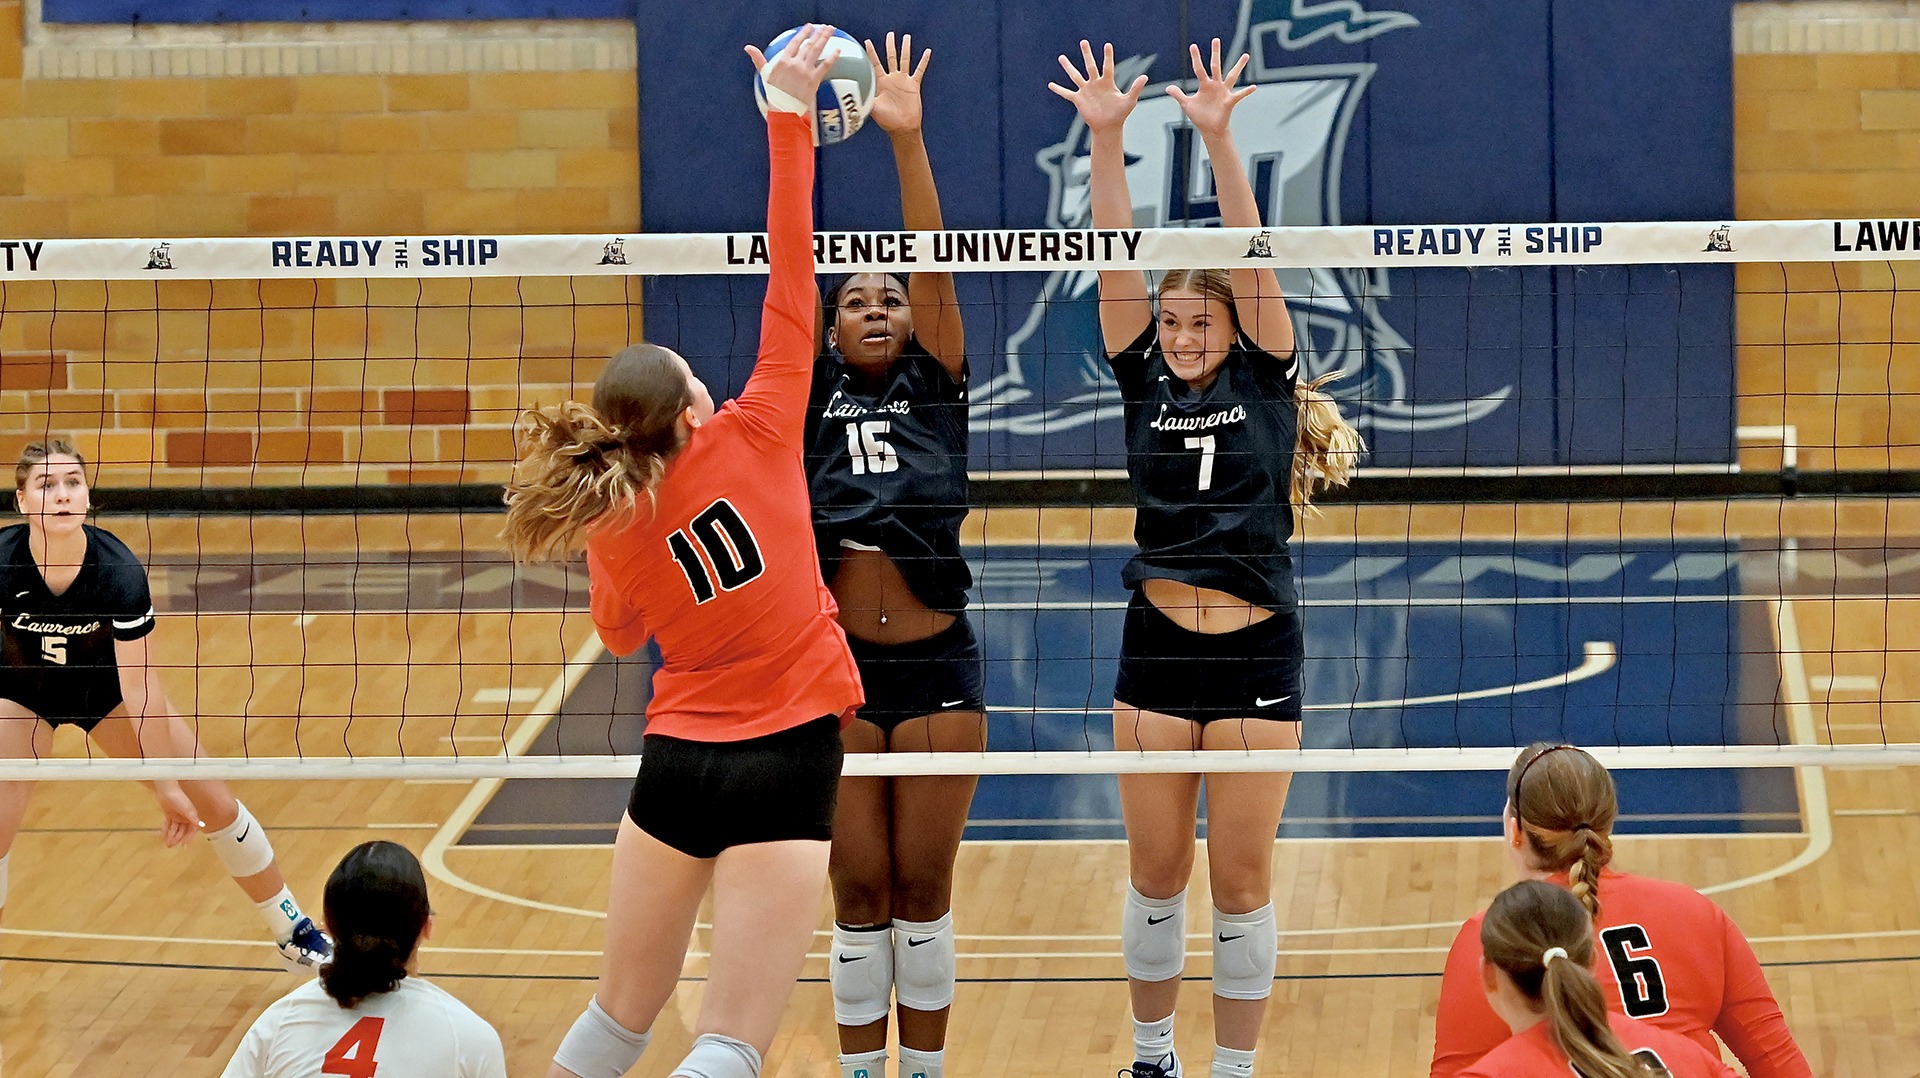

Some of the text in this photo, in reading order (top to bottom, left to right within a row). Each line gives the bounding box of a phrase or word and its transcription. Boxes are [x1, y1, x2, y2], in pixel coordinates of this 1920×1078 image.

[272, 239, 498, 269] READY THE SHIP
[727, 231, 1143, 265] LARENCE UNIVERSITY
[1373, 227, 1603, 257] READY THE SHIP
[846, 420, 899, 475] 16
[1184, 435, 1216, 491] 7
[665, 497, 766, 605] 10
[11, 612, 101, 635] Lawrence
[41, 636, 68, 665] 5
[1599, 923, 1670, 1020] 6
[320, 1015, 386, 1078] 4
